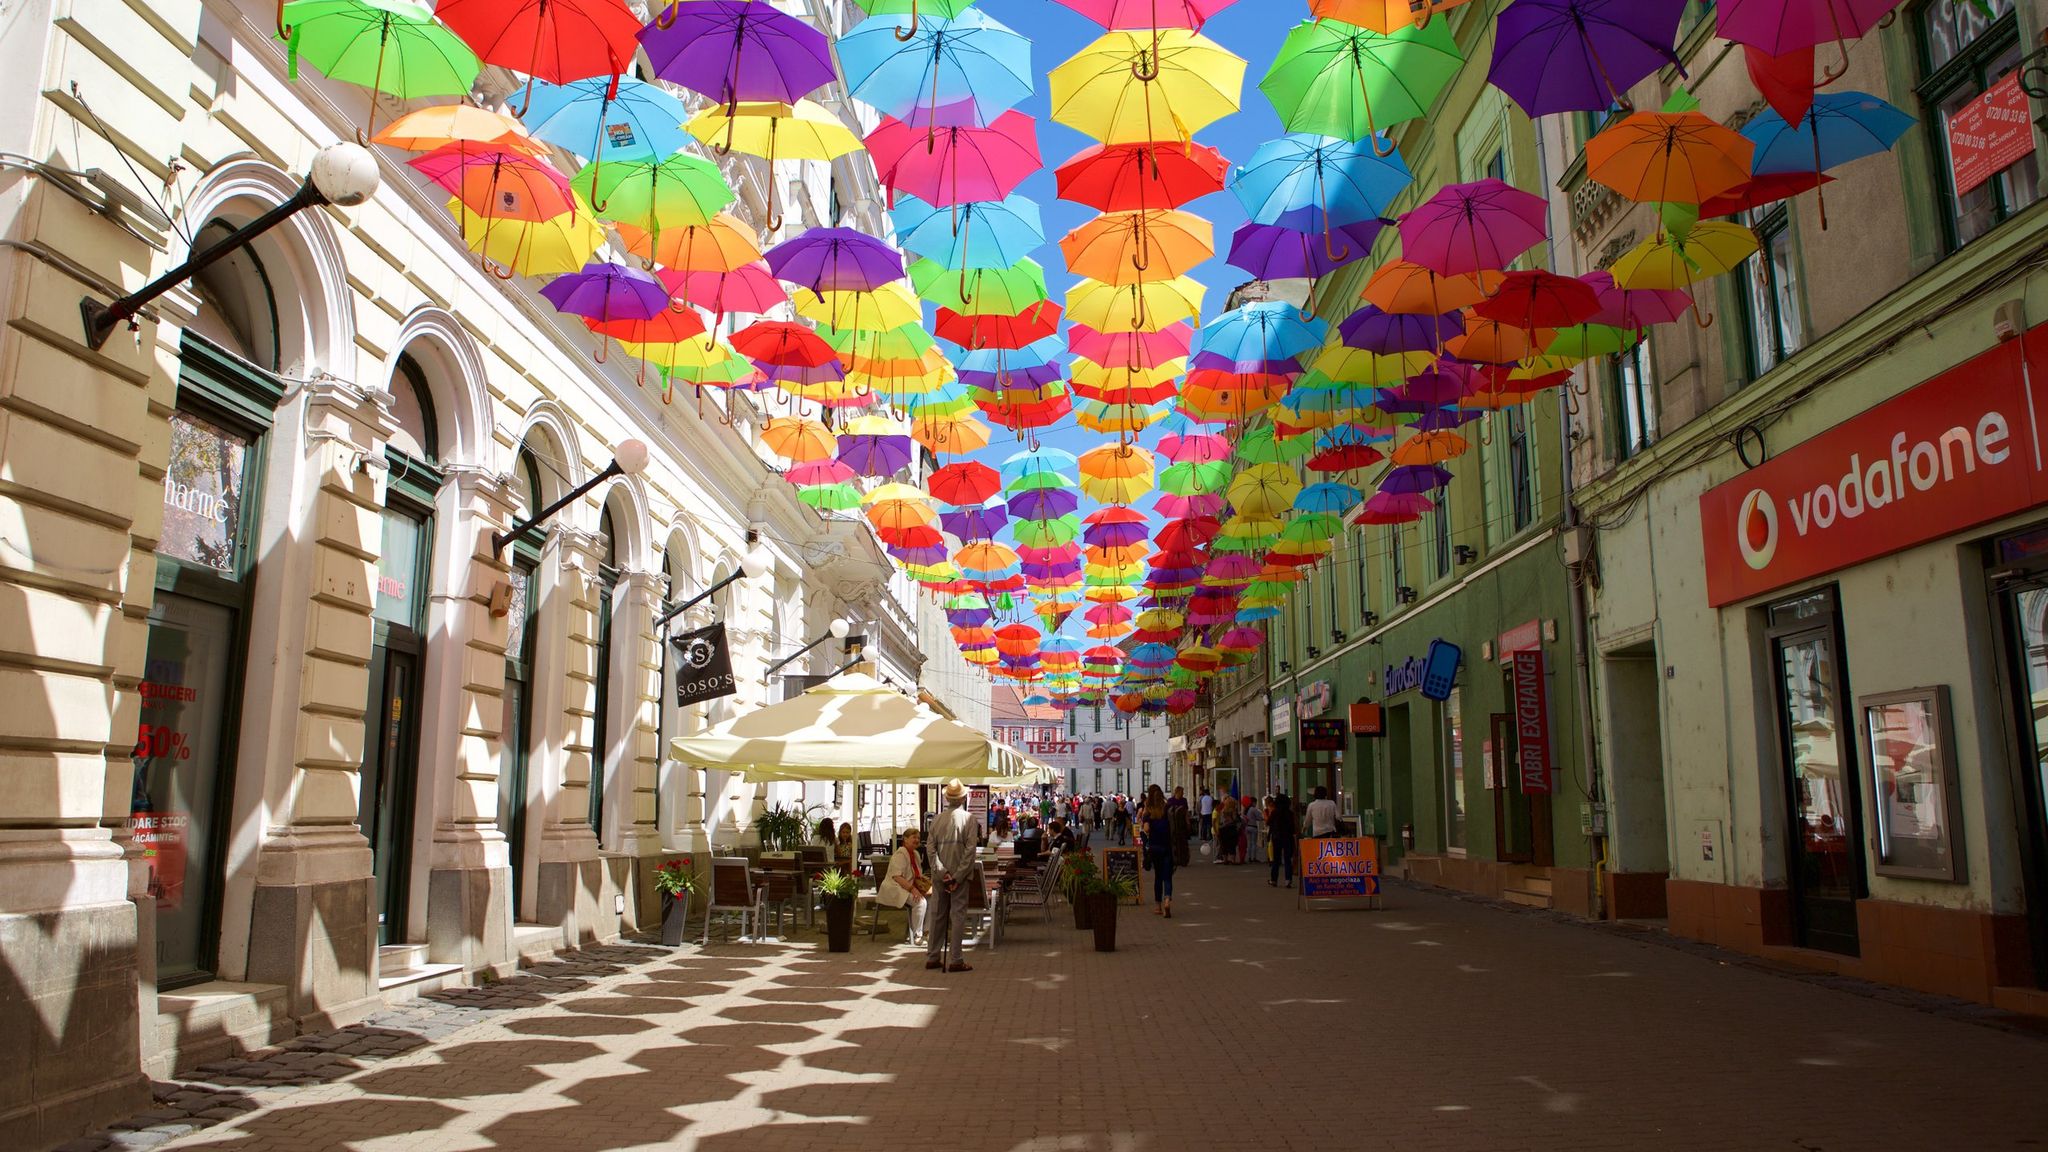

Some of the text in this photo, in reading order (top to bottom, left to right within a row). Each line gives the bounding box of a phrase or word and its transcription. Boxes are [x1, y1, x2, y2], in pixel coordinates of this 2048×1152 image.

[2007, 86, 2021, 98] FOR
[2008, 92, 2024, 106] RENT
[1969, 112, 1980, 123] FOR
[1986, 106, 2001, 121] 0720
[2001, 109, 2009, 122] 00
[2009, 110, 2018, 123] 33
[1989, 131, 1997, 141] DE
[1788, 411, 2012, 537] vodafone
[164, 463, 229, 523] harmé
[695, 648, 706, 662] S
[140, 682, 197, 702] EDUCERI
[678, 674, 733, 696] SOSO'S
[1518, 653, 1541, 738] EXCHANGE
[1352, 724, 1377, 732] orange
[136, 723, 191, 760] 50%
[1026, 741, 1079, 754] TESZT
[1524, 744, 1547, 790] JABRI
[161, 815, 187, 828] STOC
[1318, 841, 1359, 860] JABRI
[1308, 860, 1372, 875] EXCHANGE
